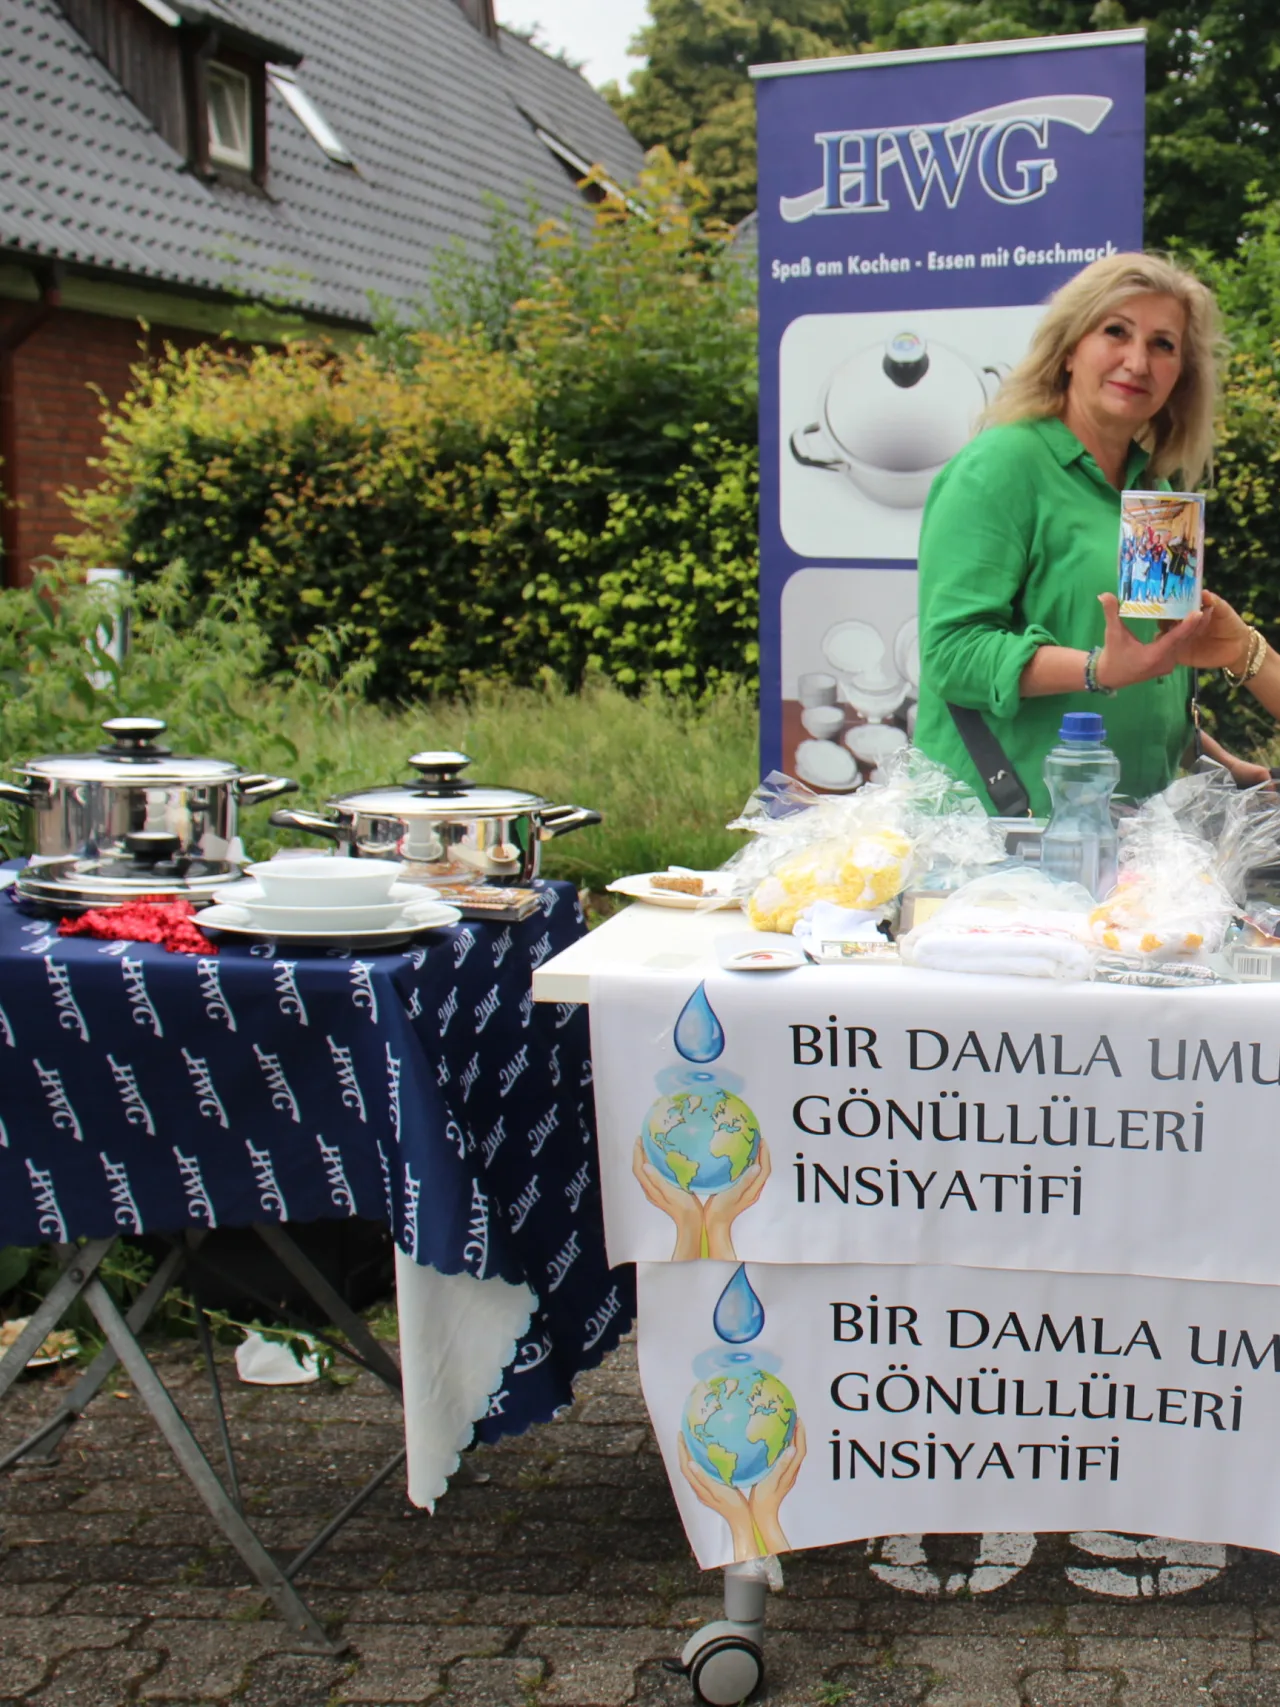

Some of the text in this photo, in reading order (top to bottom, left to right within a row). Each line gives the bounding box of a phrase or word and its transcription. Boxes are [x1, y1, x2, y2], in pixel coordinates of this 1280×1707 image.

[815, 115, 1057, 214] HWG
[771, 256, 812, 283] Spaß
[816, 260, 843, 277] am
[848, 253, 910, 275] Kochen
[928, 251, 975, 271] Essen
[981, 247, 1009, 268] mit
[1013, 240, 1118, 267] Geschmack
[789, 1015, 882, 1070] BİR
[906, 1028, 1123, 1078] DAMLA
[792, 1087, 1205, 1153] GÖNÜLLÜLERİ
[793, 1152, 1082, 1216] İNSİYATİFİ
[829, 1294, 922, 1346] BİR
[945, 1308, 1162, 1360] DAMLA
[830, 1363, 1243, 1432] GÖNÜLLÜLERİ
[829, 1429, 1121, 1481] İNSİYATİFİ
